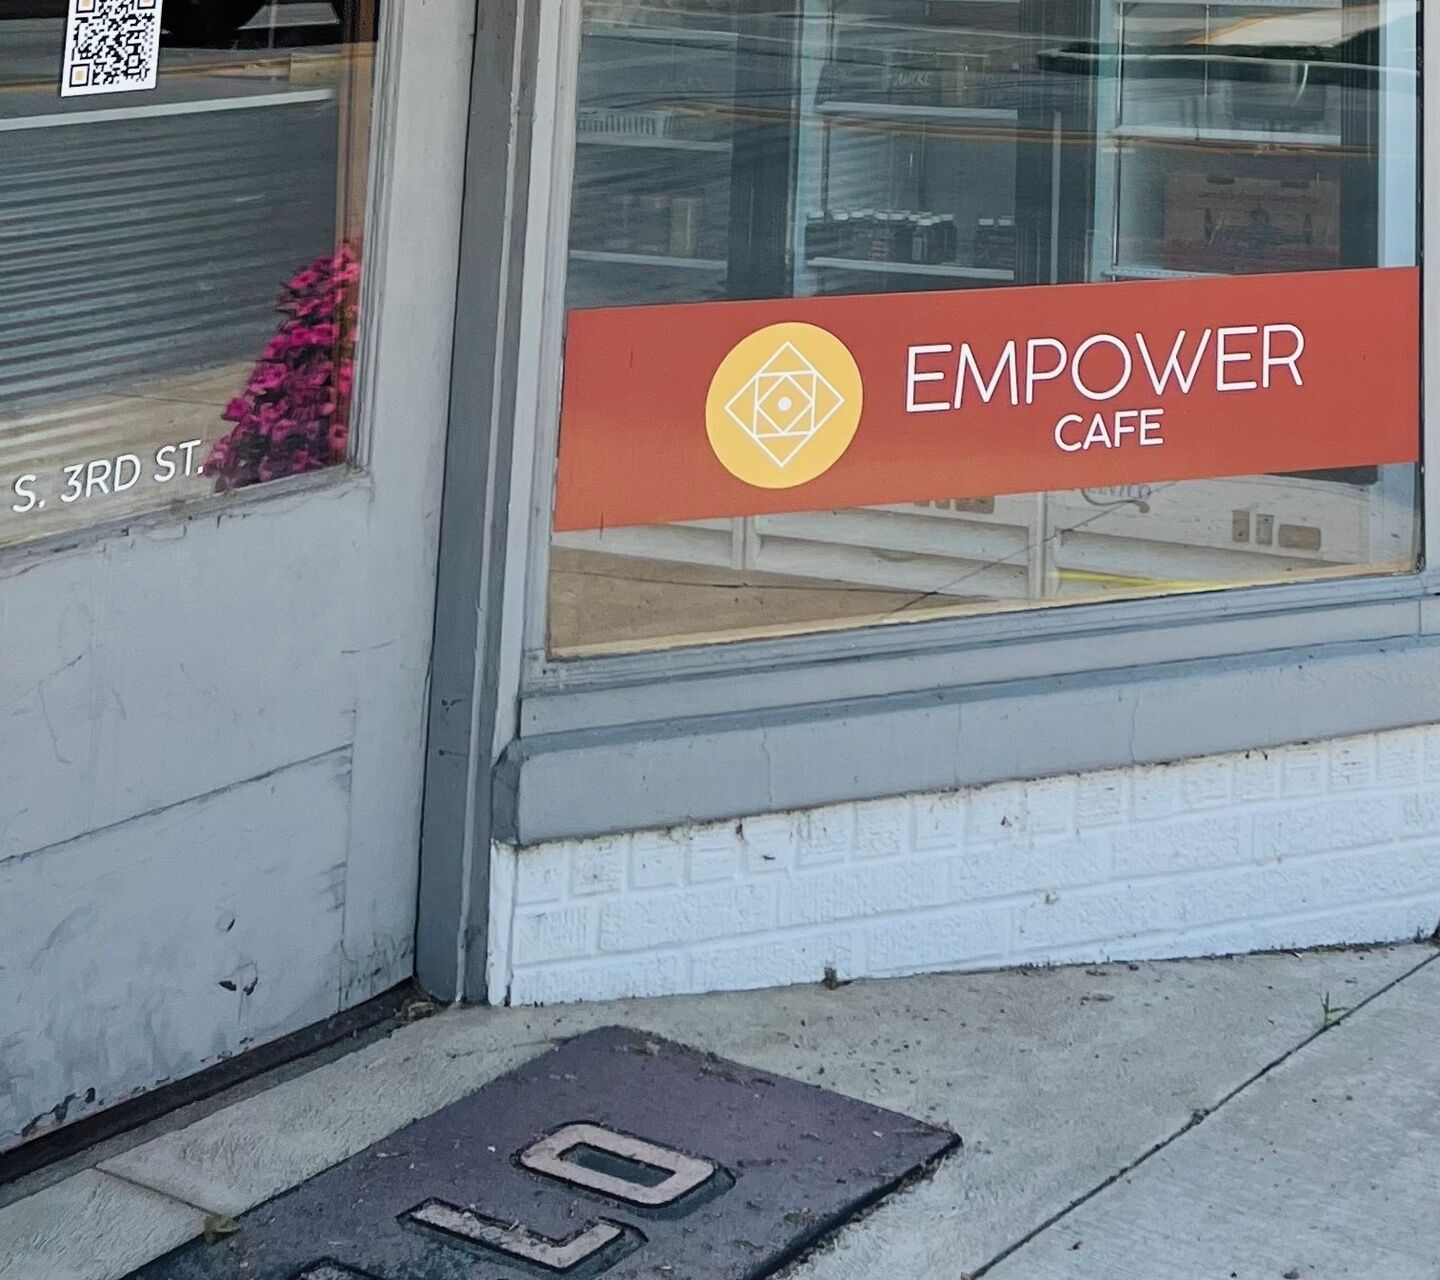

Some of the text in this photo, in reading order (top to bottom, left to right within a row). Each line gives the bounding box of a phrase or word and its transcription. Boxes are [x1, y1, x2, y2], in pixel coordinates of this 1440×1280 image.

[905, 323, 1306, 414] EMPOWER
[1054, 408, 1165, 453] CAFE
[12, 439, 204, 514] S. 3RD ST.
